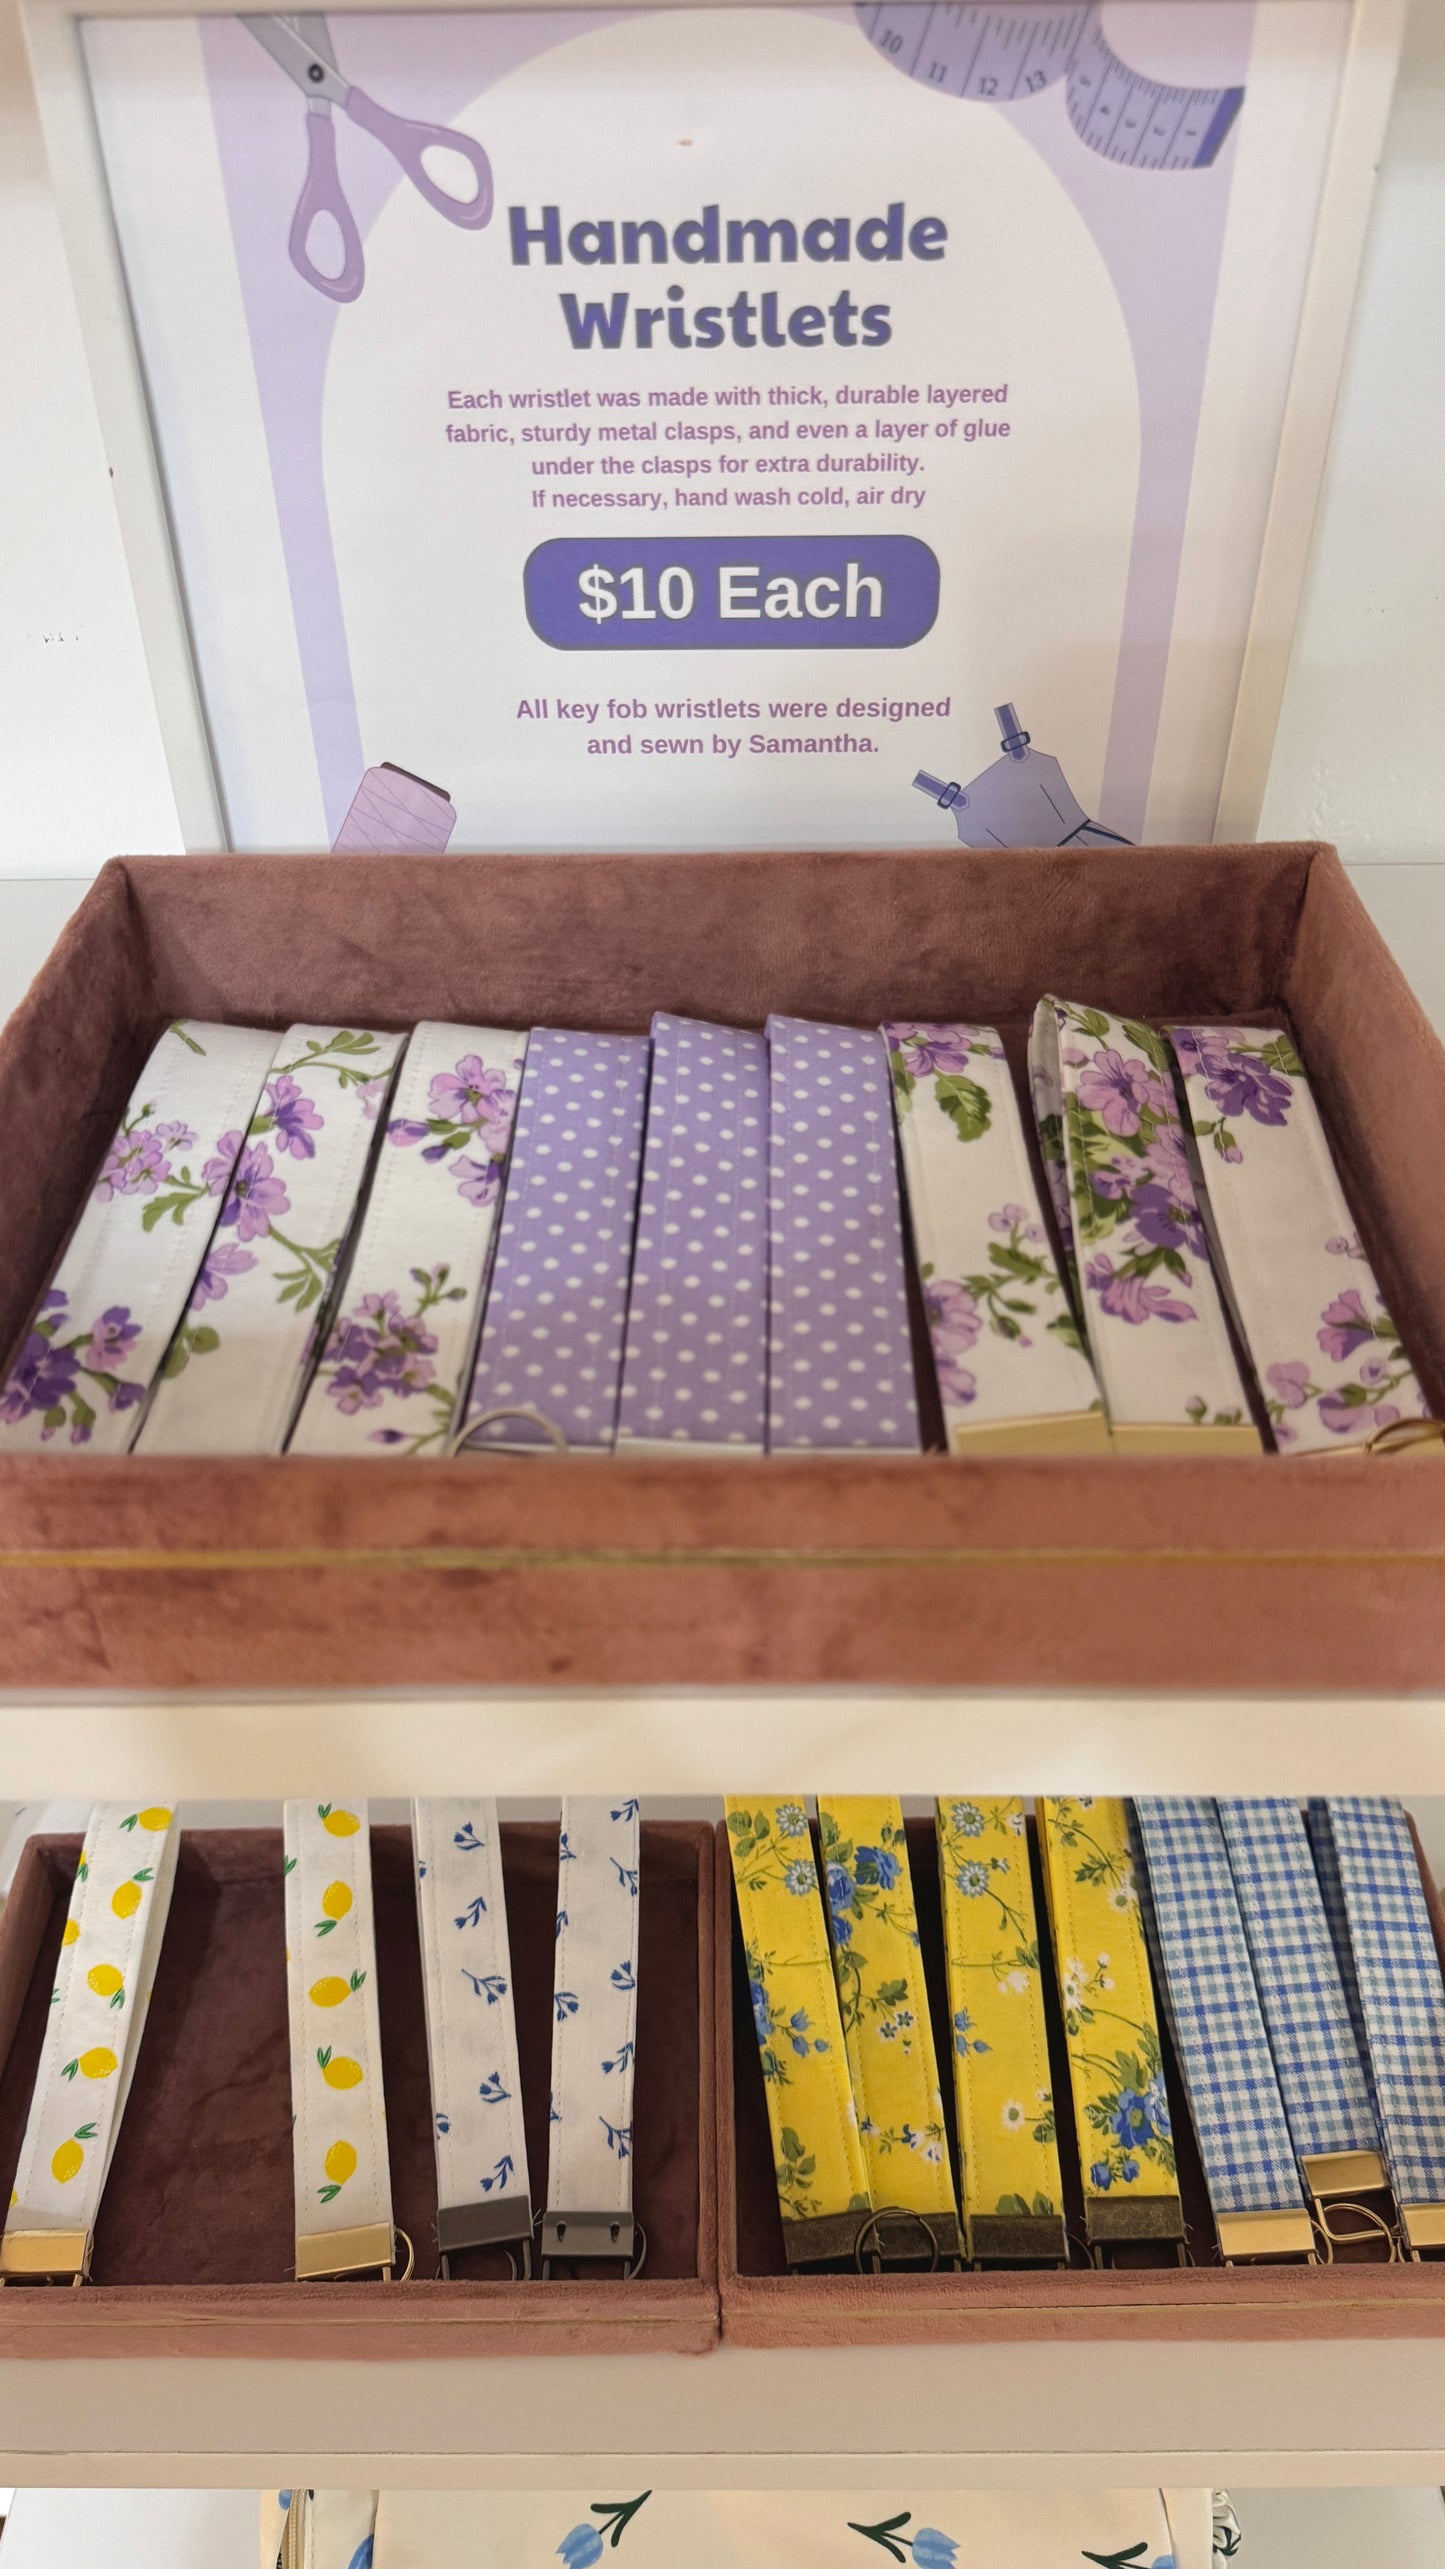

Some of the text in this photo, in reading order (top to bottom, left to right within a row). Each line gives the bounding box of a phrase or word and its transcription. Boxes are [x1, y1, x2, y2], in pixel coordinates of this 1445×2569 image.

[928, 61, 948, 83] 11
[979, 77, 999, 96] 12
[1025, 70, 1048, 93] 13
[508, 201, 948, 266] Handmade
[558, 284, 893, 350] Wristlets
[447, 383, 1009, 409] Each wristlet was made with thick, durable layered
[445, 418, 1011, 447] fabric, sturdy metal clasps, and even a layer of glue
[531, 452, 925, 479] under the clasps for extra durability.
[532, 485, 927, 512] If necessary, hand wash cold, air dry
[578, 562, 882, 625] $10 Each
[516, 696, 952, 724] All key fob wristlets were designed
[587, 732, 879, 759] and sewn by Samantha.
